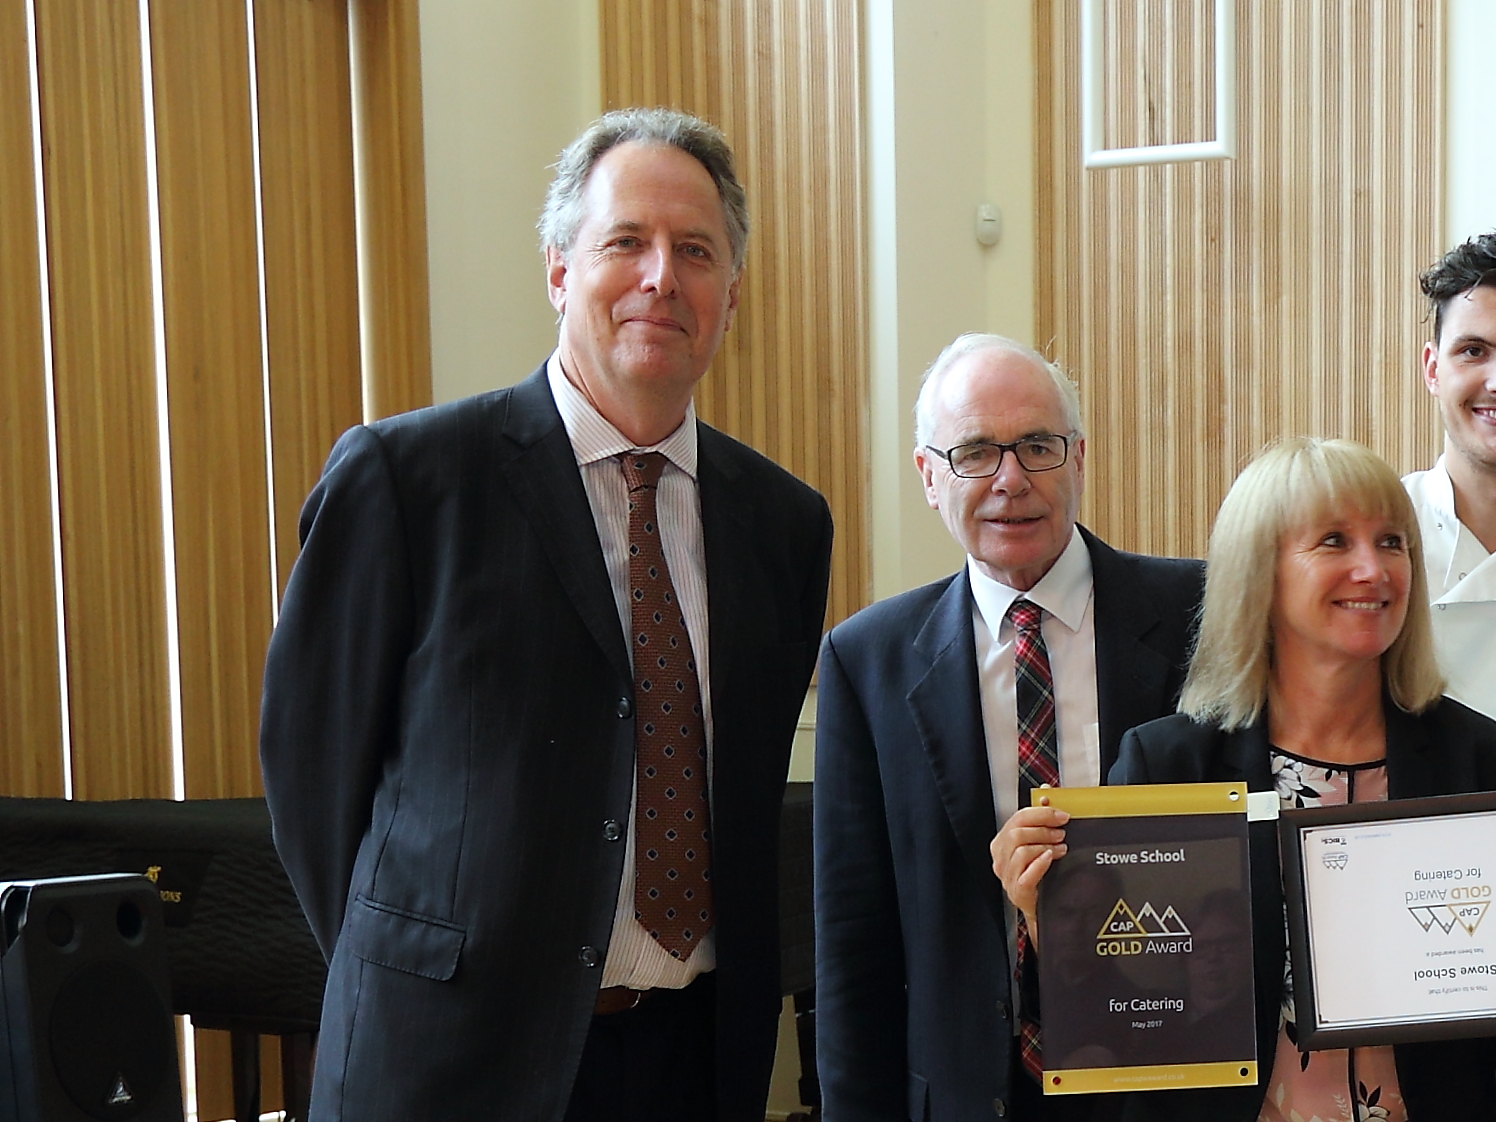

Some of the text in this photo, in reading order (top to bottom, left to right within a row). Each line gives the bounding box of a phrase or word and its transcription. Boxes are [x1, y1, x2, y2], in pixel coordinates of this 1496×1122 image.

[1095, 848, 1185, 865] Stowe School
[1415, 867, 1481, 882] for Catering
[1406, 886, 1491, 904] GOLD Award
[1459, 908, 1480, 917] CAP
[1110, 921, 1134, 932] CAP
[1096, 937, 1193, 956] GOLD Award
[1415, 968, 1456, 981] School
[1109, 997, 1184, 1013] for Catering
[1131, 1019, 1163, 1029] May 2017
